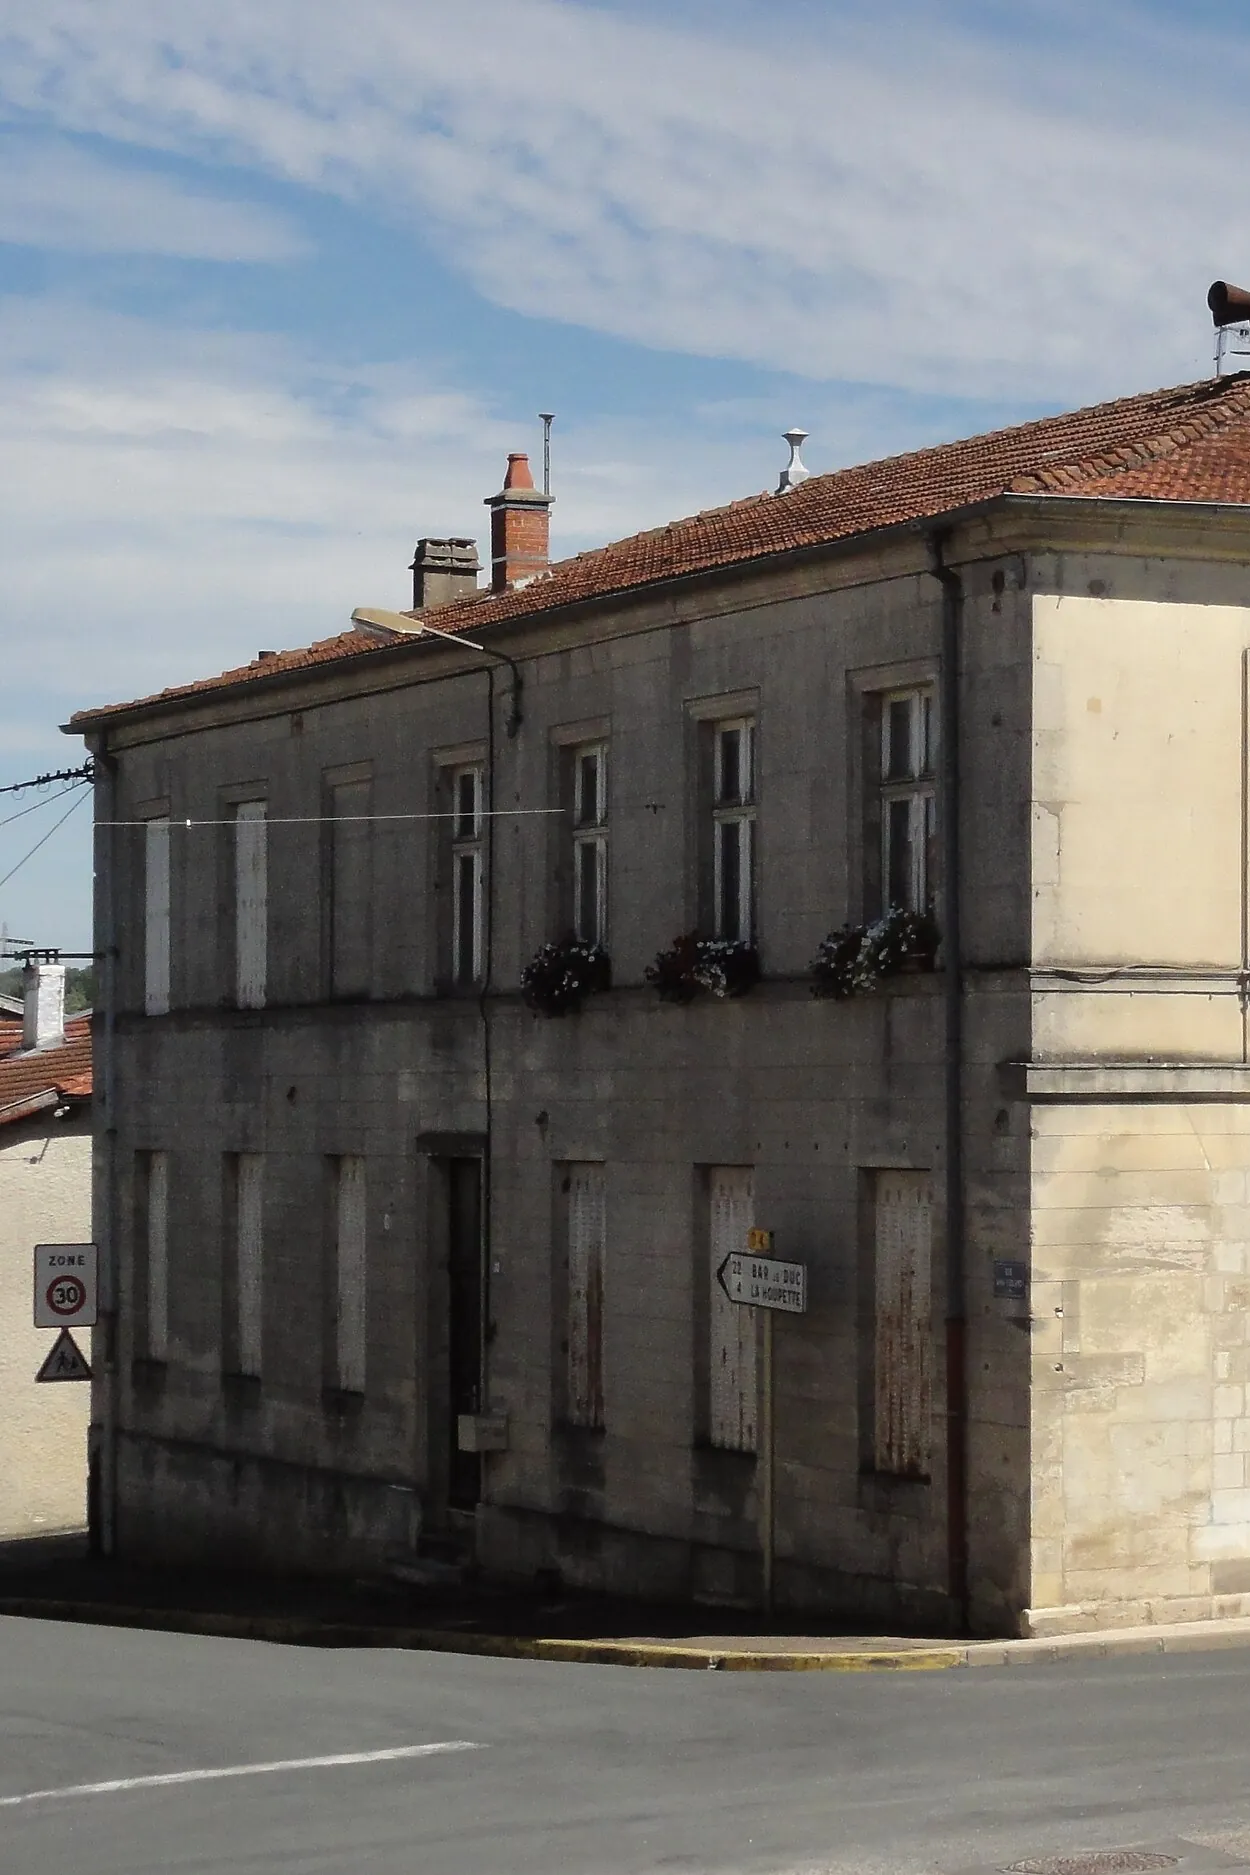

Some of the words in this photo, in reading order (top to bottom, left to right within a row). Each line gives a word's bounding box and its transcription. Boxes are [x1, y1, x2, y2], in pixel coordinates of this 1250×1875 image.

[49, 1255, 85, 1267] ZONE
[732, 1261, 742, 1275] 22
[752, 1263, 769, 1280] BAR
[783, 1269, 801, 1286] DUC
[54, 1286, 79, 1304] 30
